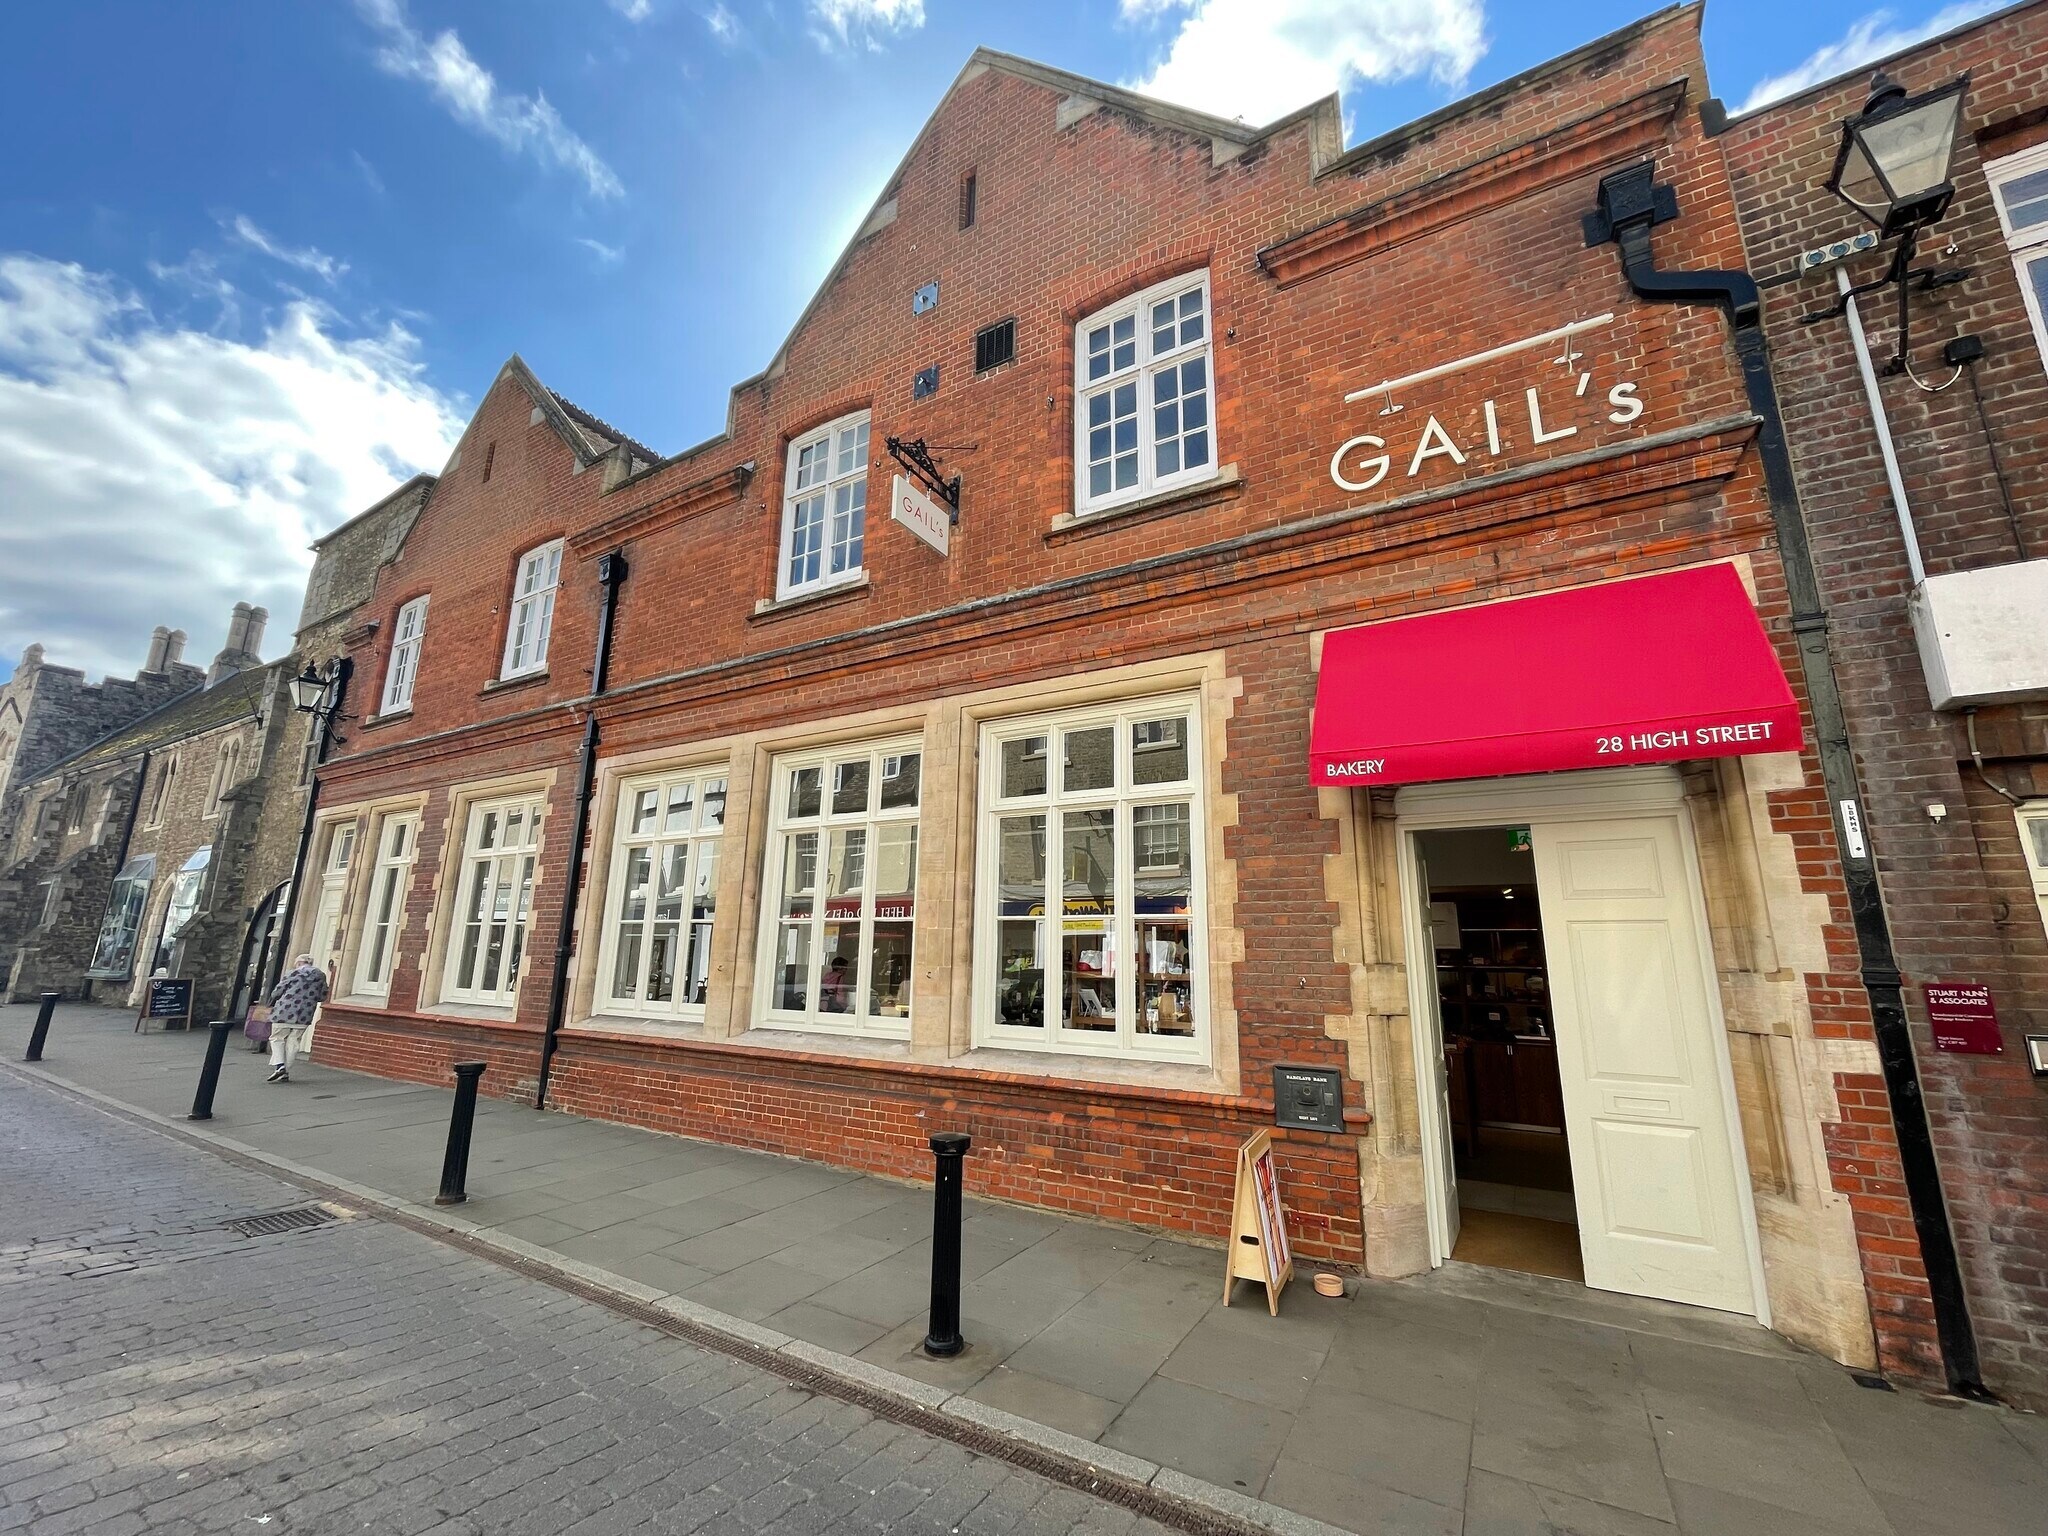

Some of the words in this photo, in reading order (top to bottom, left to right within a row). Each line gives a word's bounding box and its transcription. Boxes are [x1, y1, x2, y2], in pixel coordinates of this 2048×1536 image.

[1330, 372, 1644, 492] GAIL's
[902, 496, 943, 538] GAIL's
[1596, 737, 1624, 754] 28
[1630, 730, 1689, 750] HIGH
[1696, 722, 1773, 745] STREET
[1327, 759, 1384, 776] BAKERY
[1928, 989, 1958, 997] STUART
[1939, 998, 1988, 1006] ASSOCIATES
